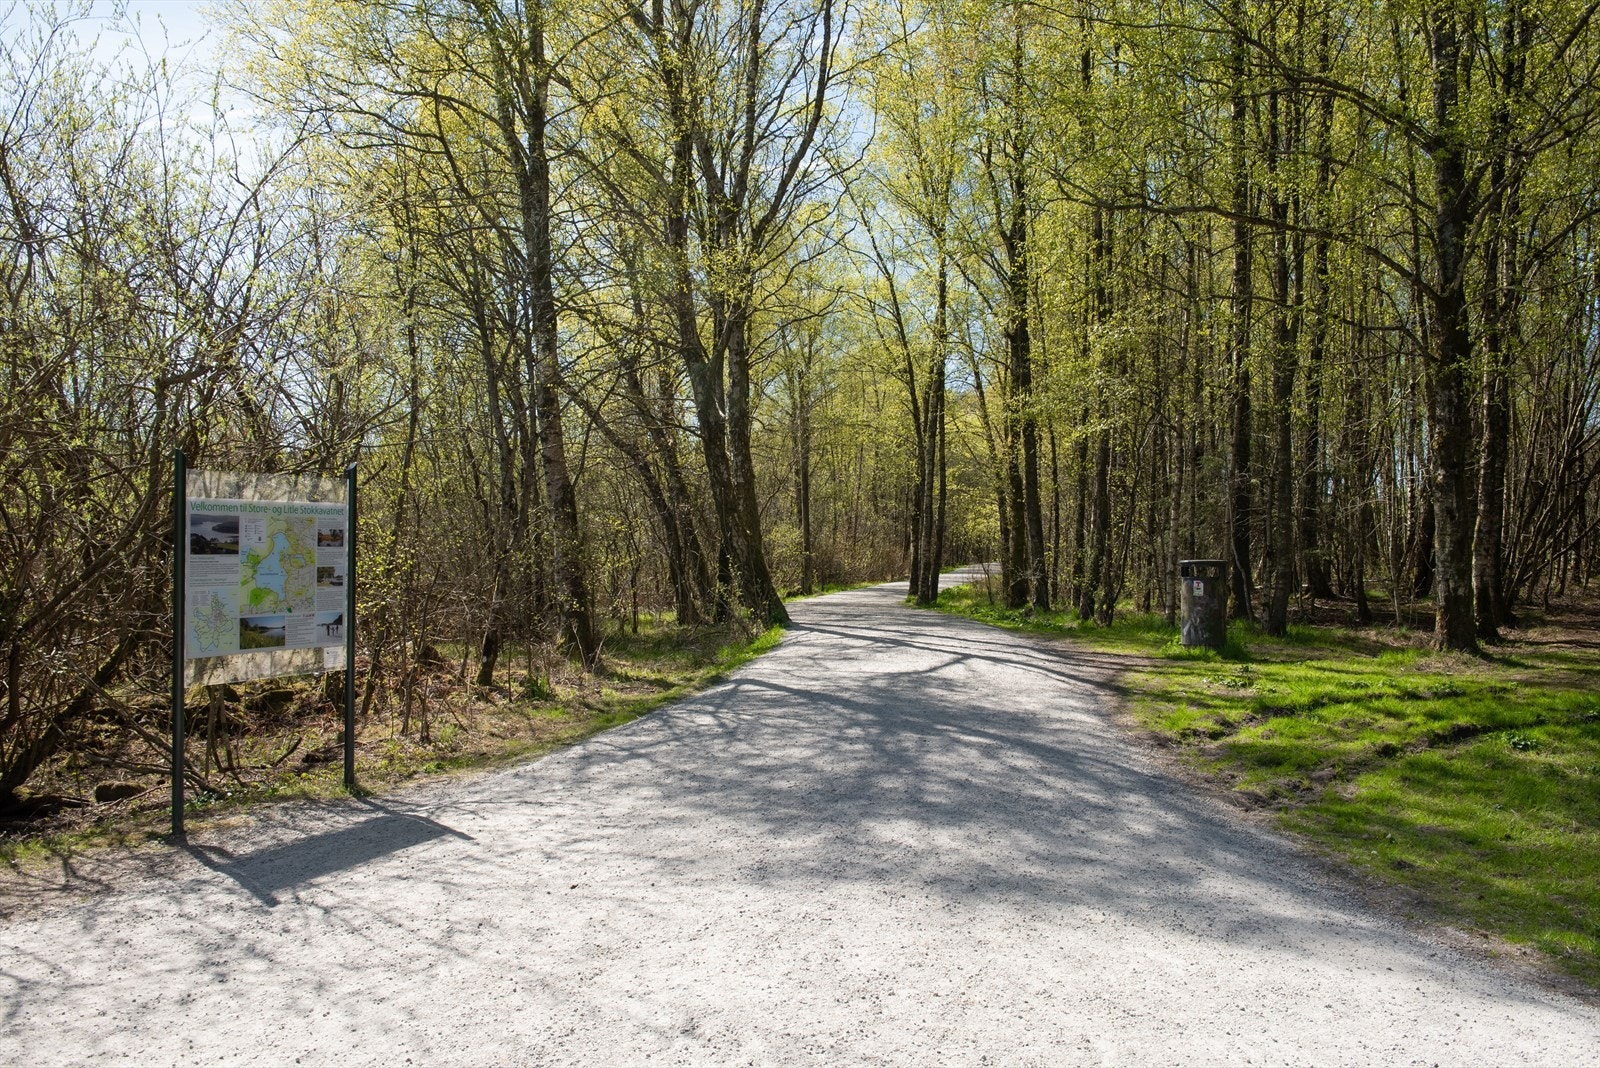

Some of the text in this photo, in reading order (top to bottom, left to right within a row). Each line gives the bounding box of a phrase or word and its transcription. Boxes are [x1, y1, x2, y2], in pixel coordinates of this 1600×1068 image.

[190, 501, 238, 512] Velkommen
[249, 503, 271, 513] Store-
[272, 505, 282, 516] og
[300, 505, 344, 515] Stokkavatnet
